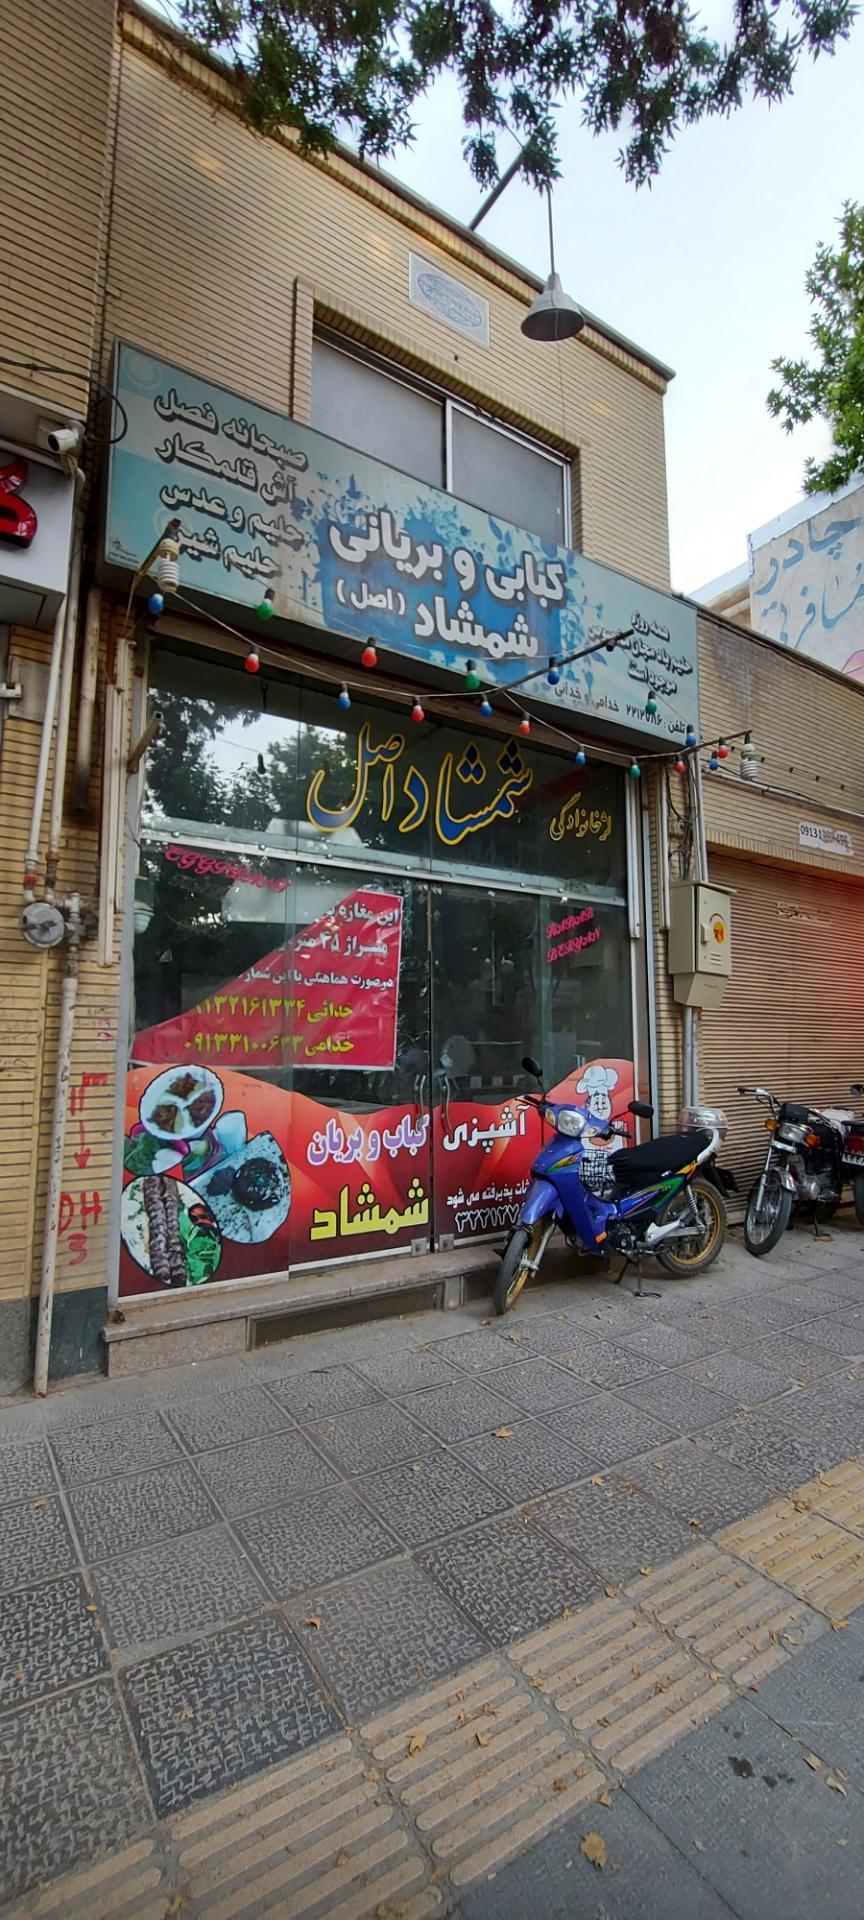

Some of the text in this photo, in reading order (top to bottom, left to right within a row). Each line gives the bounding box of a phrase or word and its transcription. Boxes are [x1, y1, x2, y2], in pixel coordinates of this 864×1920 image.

[154, 388, 309, 472] صبحانه فصل
[155, 432, 298, 506] آش قلمکار
[160, 484, 306, 546] حلیم و عدس
[222, 545, 282, 580] حلیم
[329, 510, 567, 608] کبابی و بریانی
[414, 596, 539, 658] شمشاد
[307, 721, 533, 845] شمشاد اصل
[550, 791, 602, 841] خانوادگی
[338, 901, 375, 923] مغازه
[376, 908, 400, 927] این
[342, 934, 390, 958] متراژ
[293, 968, 303, 985] با
[304, 971, 349, 987] هماهنگی
[304, 1035, 355, 1057] خدامی
[307, 1113, 430, 1166] کباب و بریان
[443, 1104, 531, 1154] آشپزی
[310, 1177, 430, 1242] شمشاد
[446, 1187, 465, 1208] شود
[466, 1191, 480, 1206] می
[482, 1182, 513, 1203] پذیرفته
[455, 1202, 526, 1233] ۳۲۲۱۲۷
